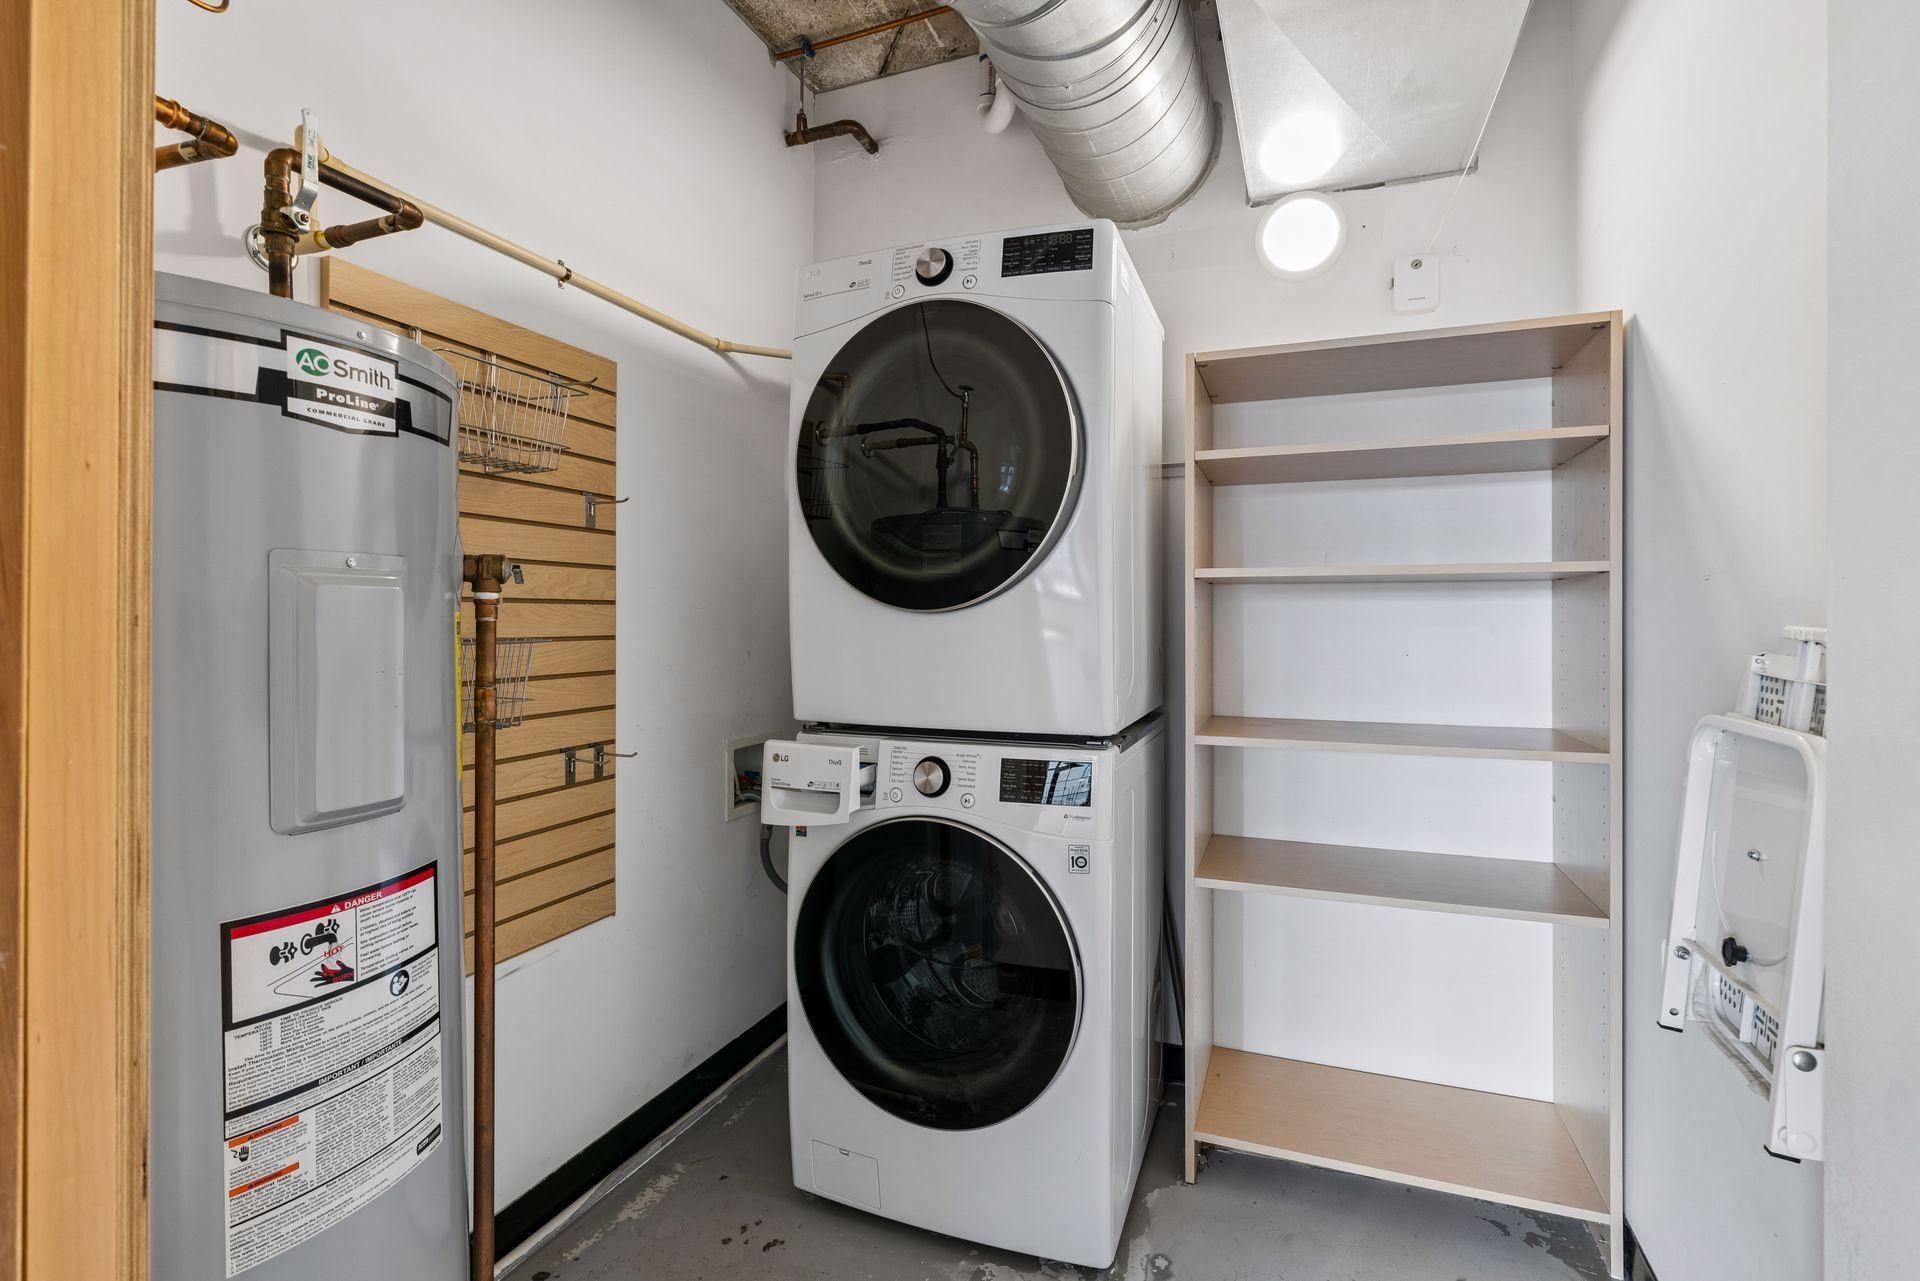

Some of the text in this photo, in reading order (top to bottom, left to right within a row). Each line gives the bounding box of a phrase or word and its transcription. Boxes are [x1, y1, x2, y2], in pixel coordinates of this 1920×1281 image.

[300, 350, 391, 390] AO Smith
[307, 407, 386, 428] COMMERCIAL GRADE
[1071, 856, 1087, 869] 10
[344, 891, 383, 910] DANGER
[323, 945, 344, 958] HOT
[318, 1060, 359, 1084] IMPORTANT
